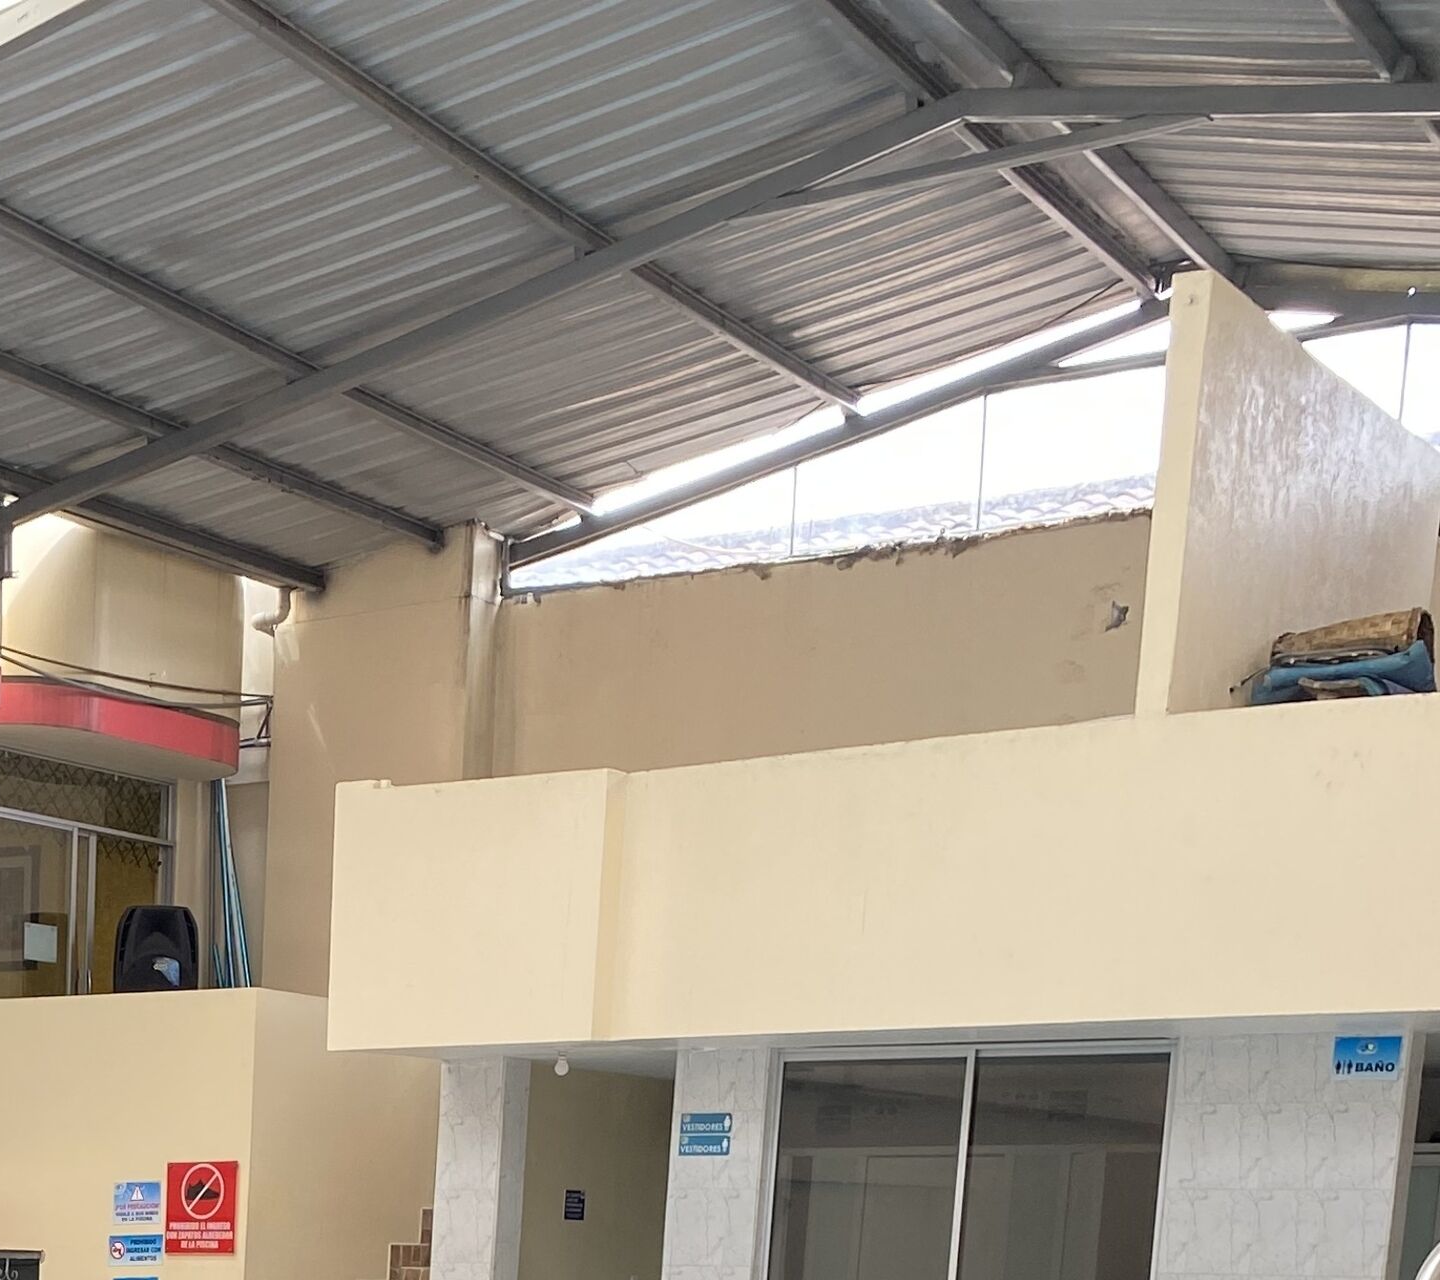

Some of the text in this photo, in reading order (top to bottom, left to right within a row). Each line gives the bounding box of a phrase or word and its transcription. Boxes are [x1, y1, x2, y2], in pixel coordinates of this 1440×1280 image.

[1354, 1060, 1395, 1073] BAÑO
[682, 1122, 723, 1131] VESTIDORES
[680, 1145, 721, 1153] VESTIDORES
